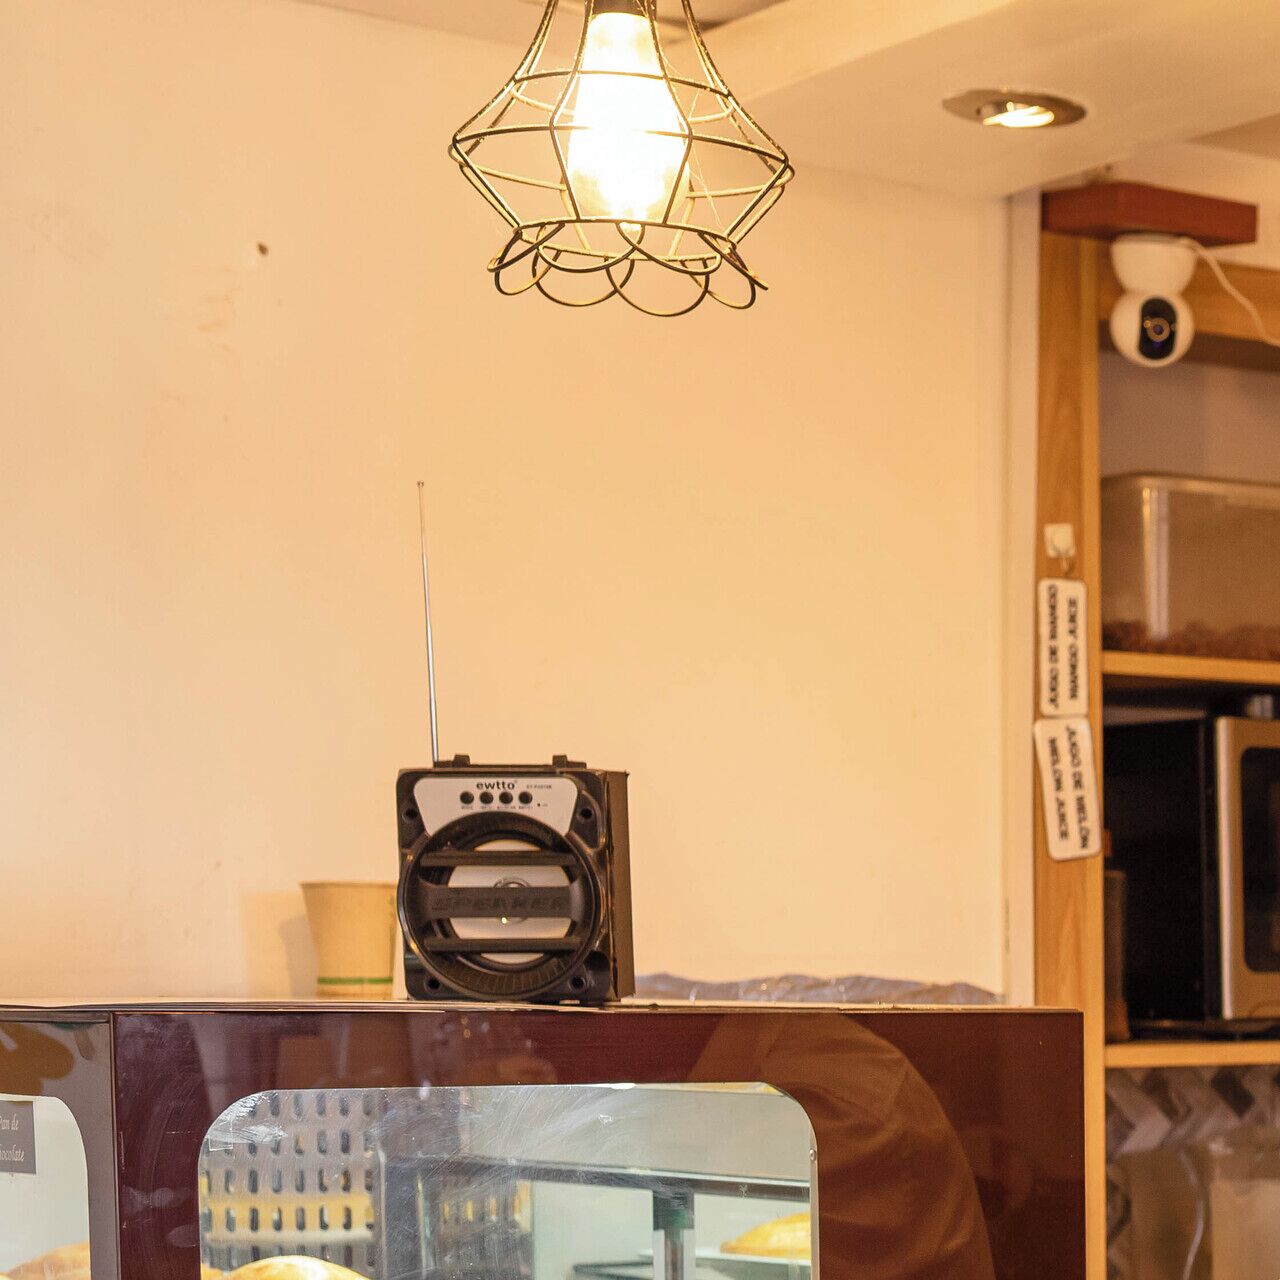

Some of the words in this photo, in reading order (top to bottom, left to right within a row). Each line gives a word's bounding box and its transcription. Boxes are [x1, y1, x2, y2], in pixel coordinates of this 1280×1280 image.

[1048, 645, 1058, 664] DE
[476, 780, 515, 790] ewtto
[1073, 769, 1083, 790] DE
